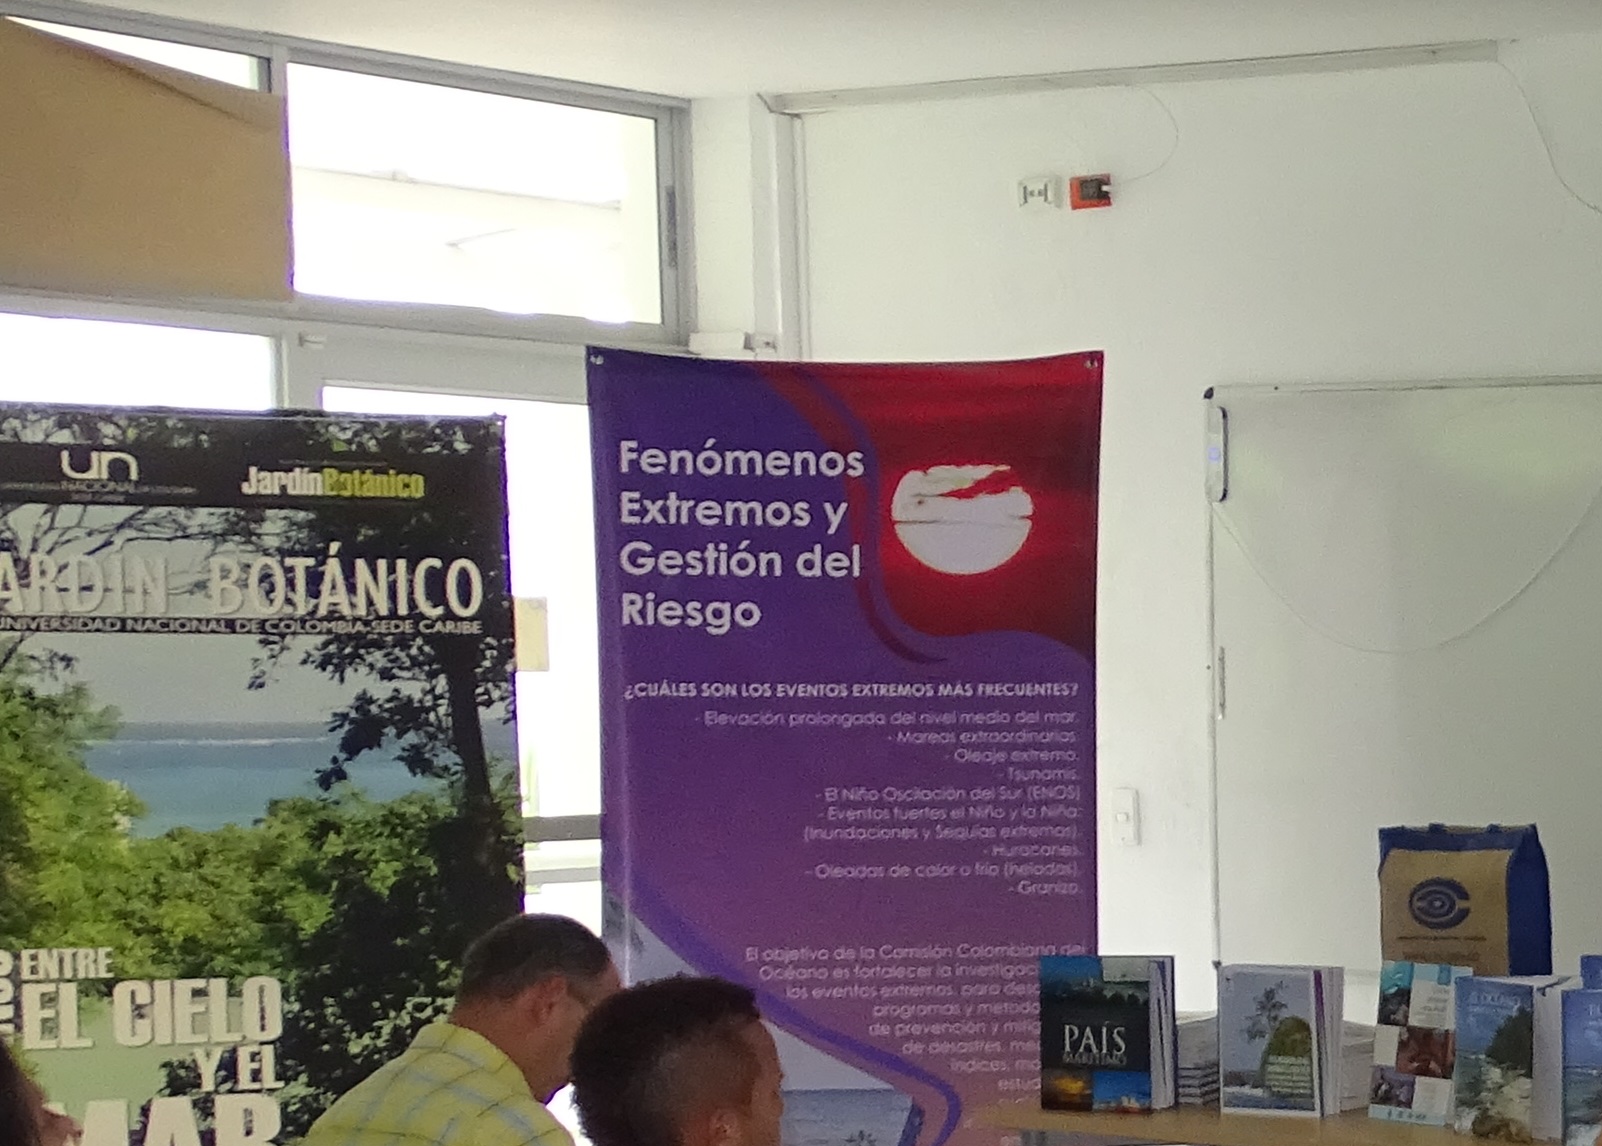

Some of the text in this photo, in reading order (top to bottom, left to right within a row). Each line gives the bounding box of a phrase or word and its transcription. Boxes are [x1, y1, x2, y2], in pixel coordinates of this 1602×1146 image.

[619, 439, 864, 477] Fenómenos
[619, 491, 848, 534] Extremos y
[619, 540, 861, 579] Gestión del
[210, 541, 484, 617] BOTÁNICO
[621, 592, 762, 635] Riesgo
[126, 617, 233, 633] NACIONAL
[235, 618, 260, 633] DE
[418, 620, 483, 635] CARIBE
[624, 679, 1080, 702] ¿CUÁLES SON LOS EVENTOS EXTREMOS MÁS FRECUENTES?
[704, 708, 787, 727] Elevación
[788, 709, 887, 730] prolongada
[889, 709, 917, 724] del
[919, 709, 958, 724] nivel
[959, 709, 1011, 724] medio
[1013, 709, 1039, 724] del
[895, 729, 957, 745] Mareas
[953, 748, 1007, 766] Oleaje
[824, 785, 1081, 802] El Niño Oscilación del Sur (ENOS)
[827, 805, 1037, 823] Eventos fuertes el Niño y la
[803, 825, 918, 843] (Inundaciones
[920, 828, 932, 843] y
[814, 861, 887, 880] Oleadas
[889, 862, 913, 878] de
[915, 862, 958, 878] calor
[20, 948, 115, 980] ENTRE
[745, 943, 1056, 966] El objetivo de la Comisión Colombiana
[759, 964, 952, 982] Océano es fortalecer la
[785, 984, 809, 999] los
[811, 984, 877, 999] eventos
[960, 985, 1001, 1001] para
[22, 982, 95, 1050] EL
[113, 975, 284, 1047] CIELO
[873, 1001, 960, 1019] programas
[868, 1019, 987, 1037] de prevención
[1064, 1021, 1127, 1055] PAÍS
[901, 1040, 925, 1055] de
[194, 1044, 285, 1092] Y EL
